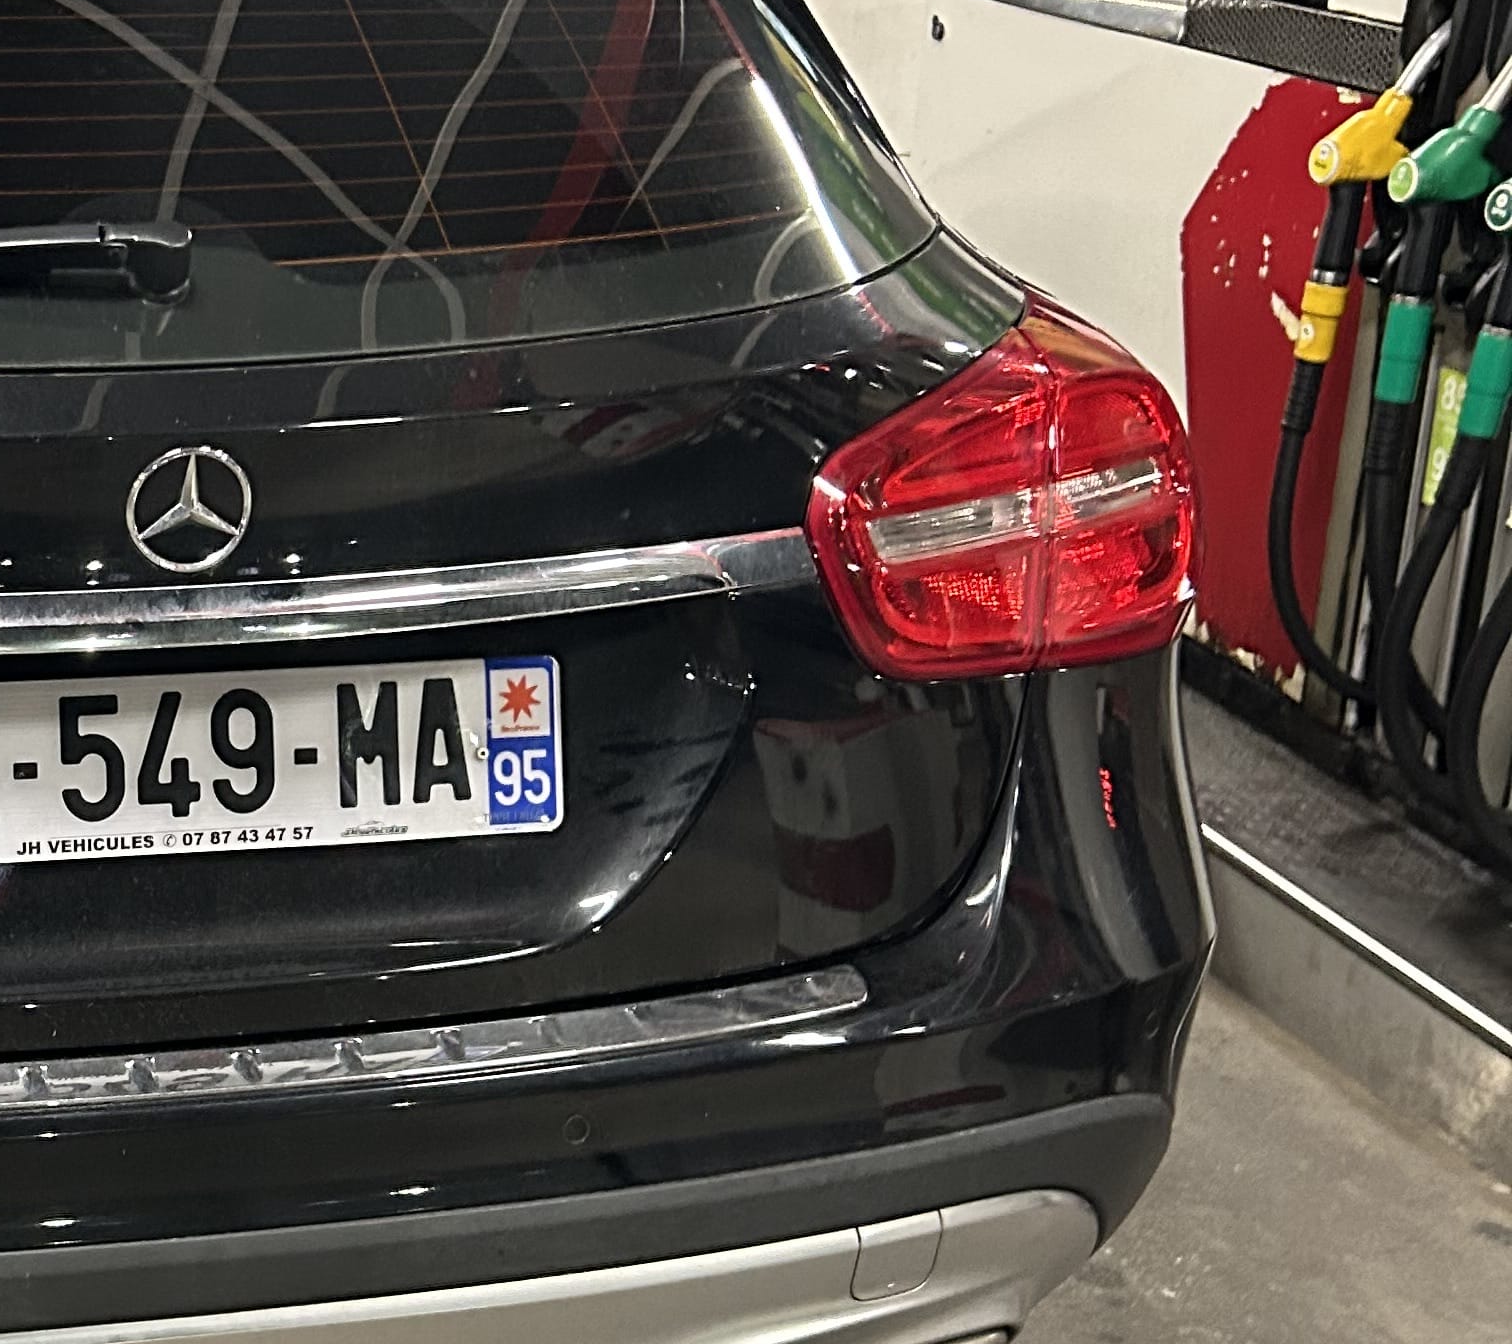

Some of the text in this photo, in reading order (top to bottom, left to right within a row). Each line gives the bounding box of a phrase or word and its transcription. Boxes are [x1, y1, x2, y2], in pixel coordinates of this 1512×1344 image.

[493, 749, 551, 806] 95
[16, 826, 314, 856] JH VEHICULES 07 87 43 47 57
